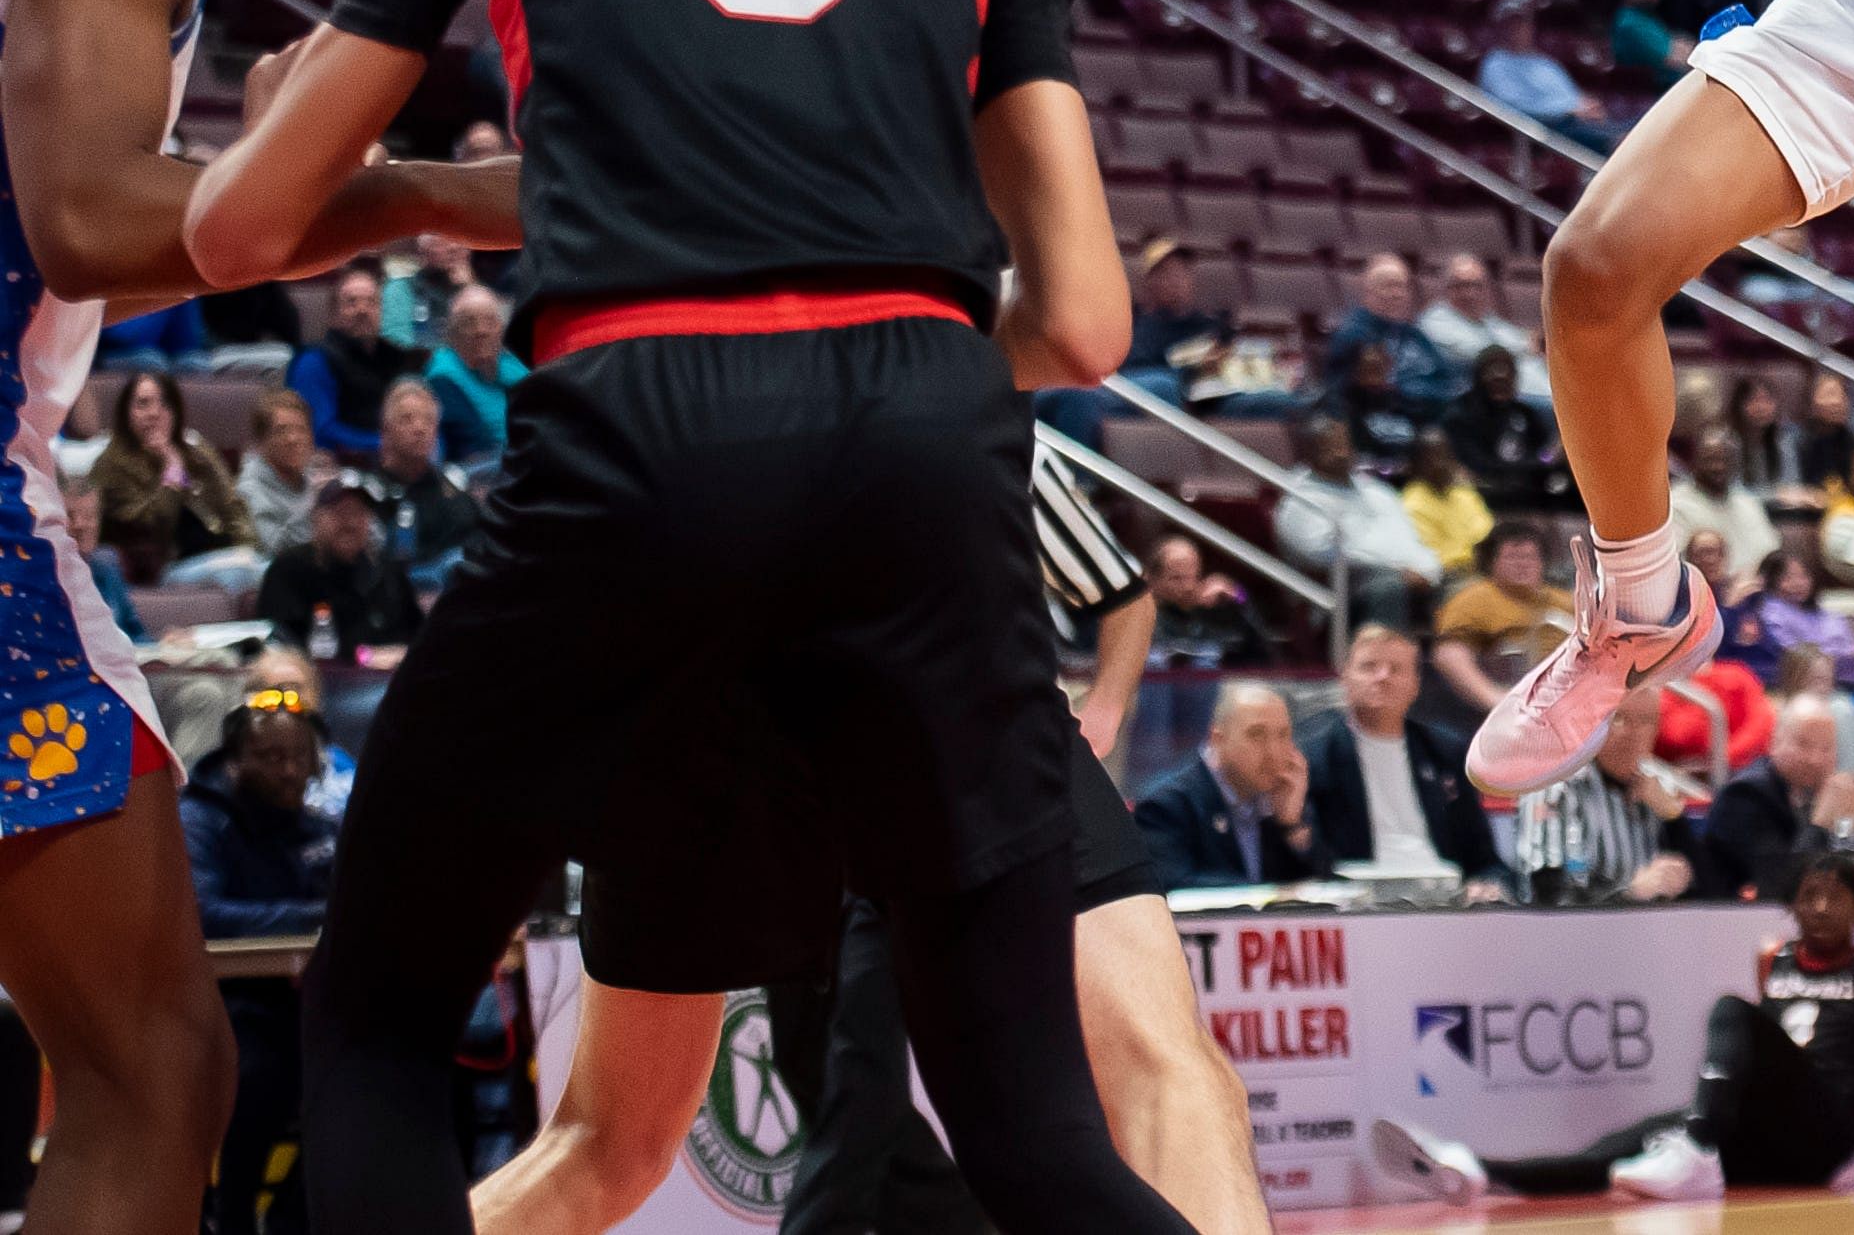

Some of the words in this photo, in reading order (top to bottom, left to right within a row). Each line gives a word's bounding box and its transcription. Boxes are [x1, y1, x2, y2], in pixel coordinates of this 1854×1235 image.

[1238, 928, 1347, 992] PAIN
[1209, 1007, 1350, 1061] KILLER
[1481, 999, 1654, 1076] FCCB
